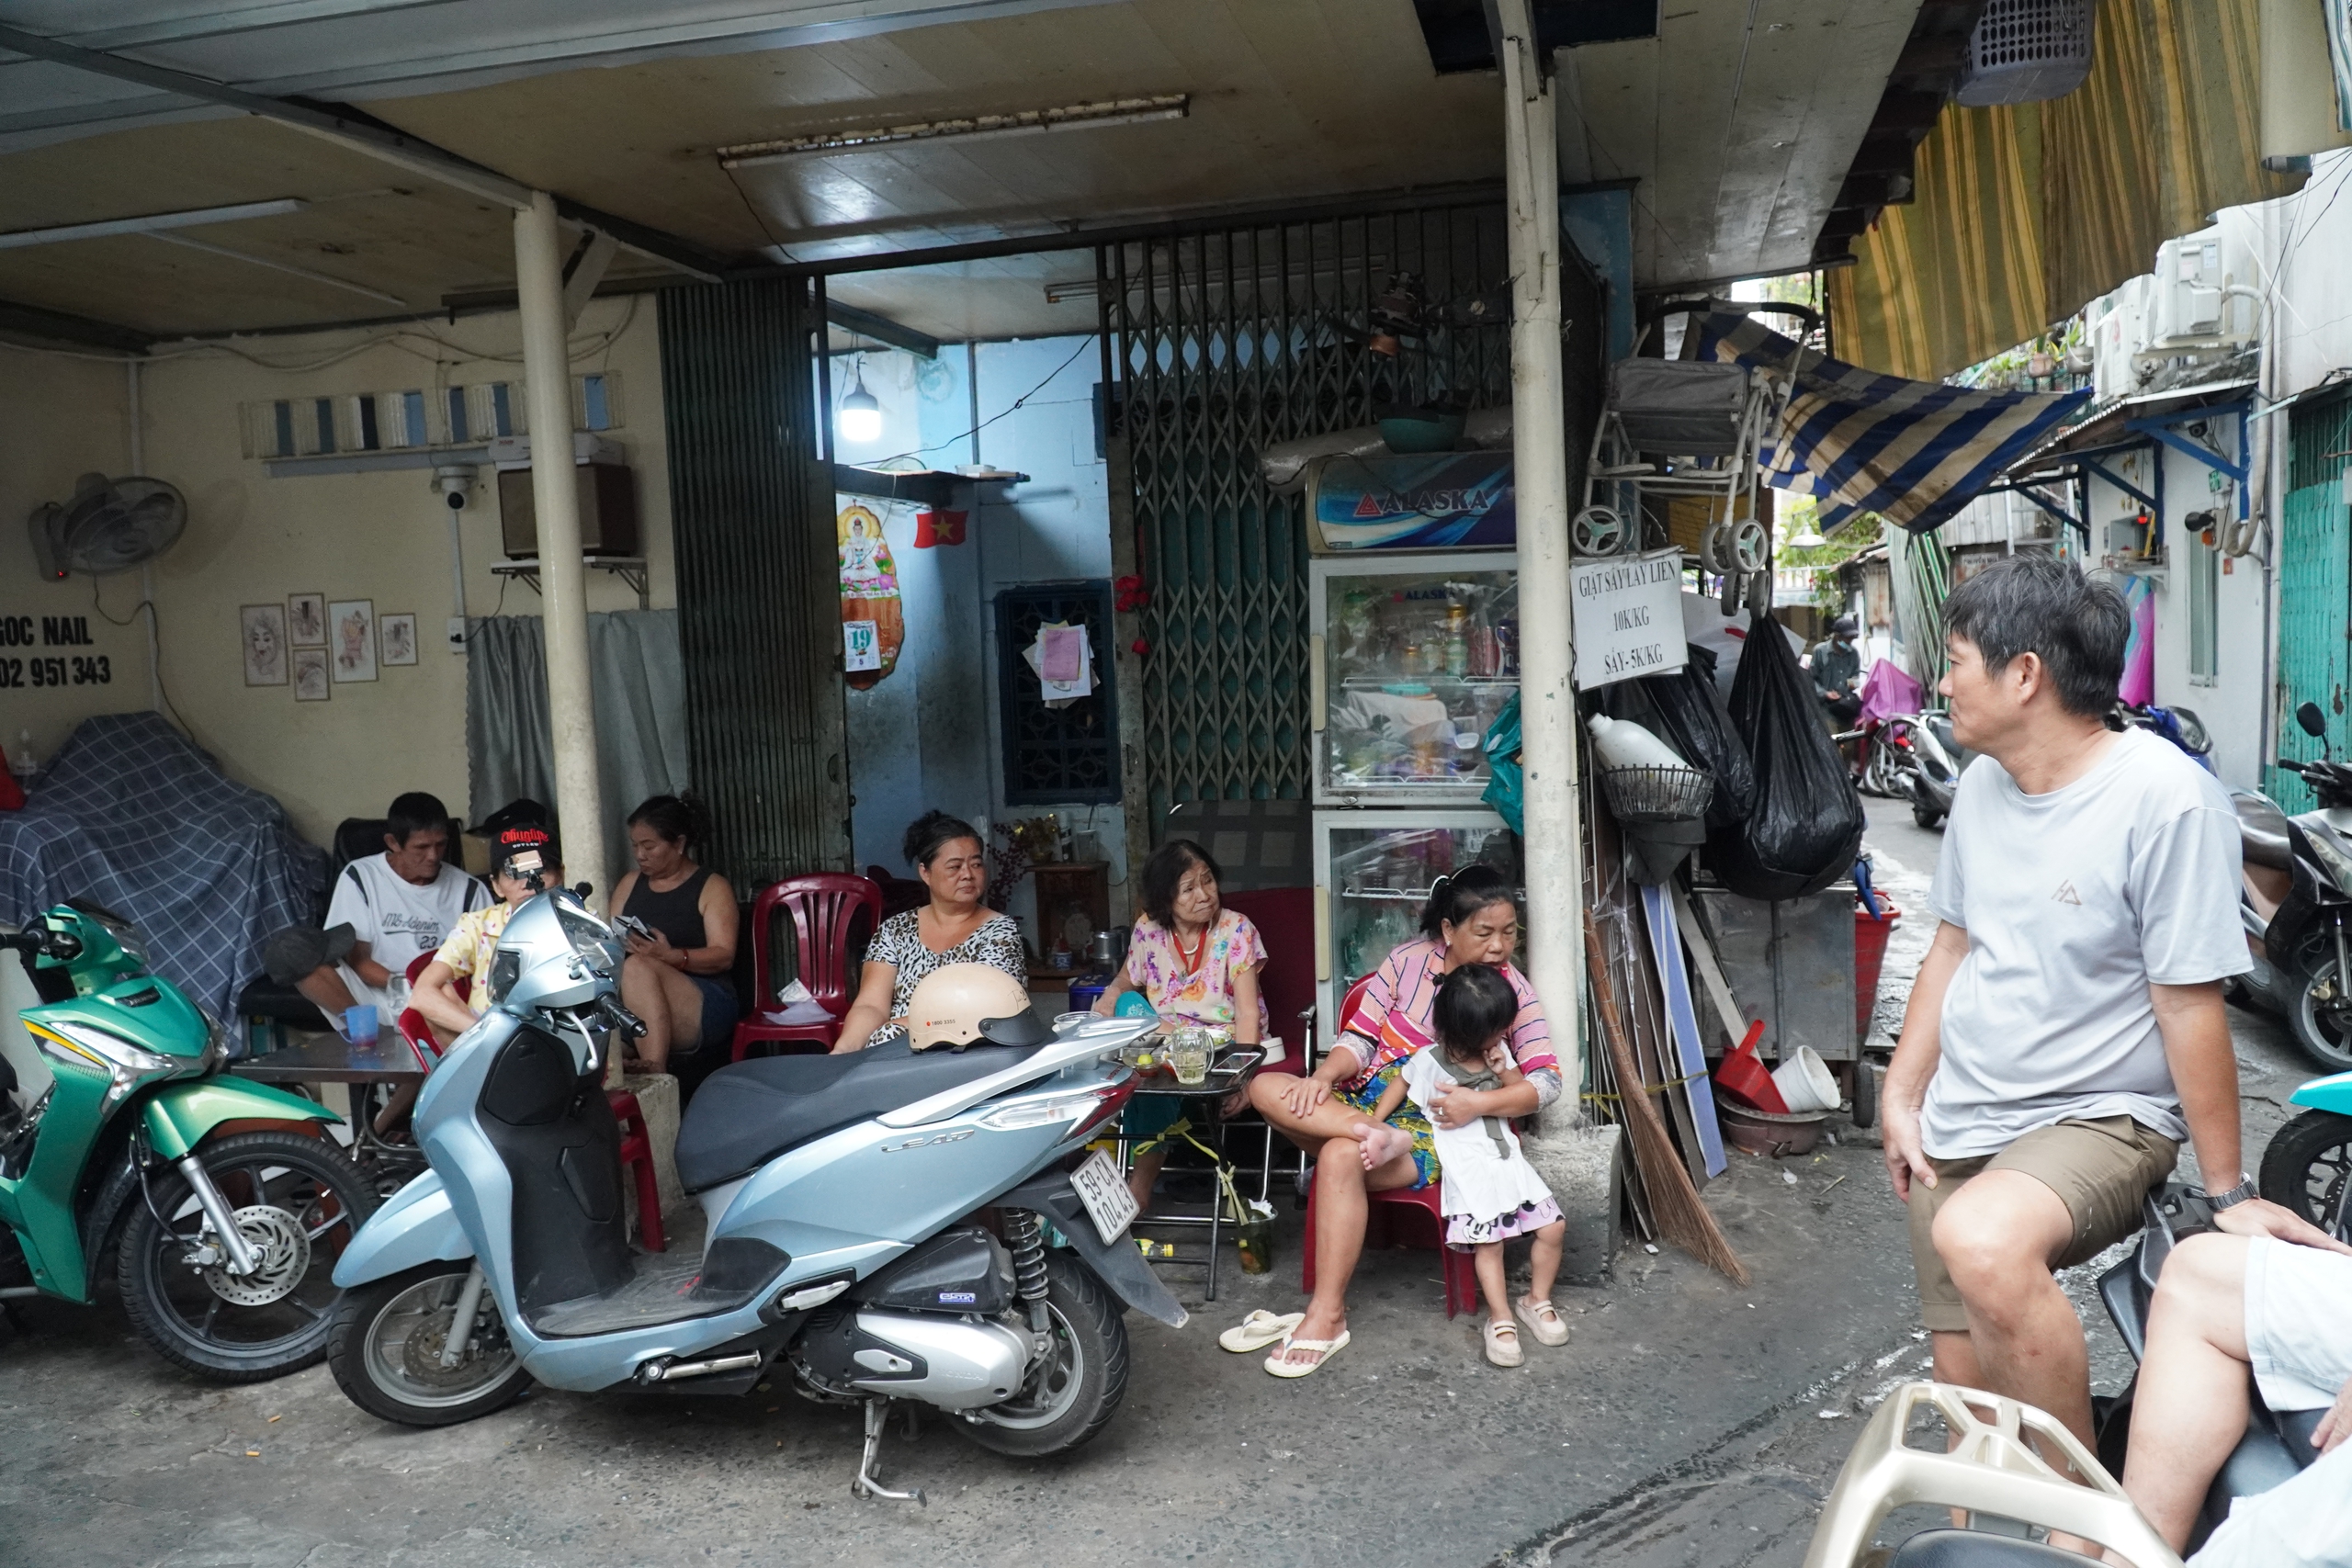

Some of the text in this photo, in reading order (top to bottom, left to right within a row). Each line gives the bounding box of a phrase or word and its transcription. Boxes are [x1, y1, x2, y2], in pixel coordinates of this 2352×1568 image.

[1381, 489, 1490, 513] ALASKA
[1579, 570, 1602, 601] GIẶT
[1605, 564, 1624, 592] SẤY
[42, 616, 94, 645] NAIL
[1613, 605, 1650, 632] 10K/KG
[851, 628, 871, 649] 19
[0, 655, 111, 688] 02 951 343
[420, 935, 438, 950] 23
[881, 1129, 975, 1153] LEAD
[1096, 1183, 1135, 1235] 104.43
